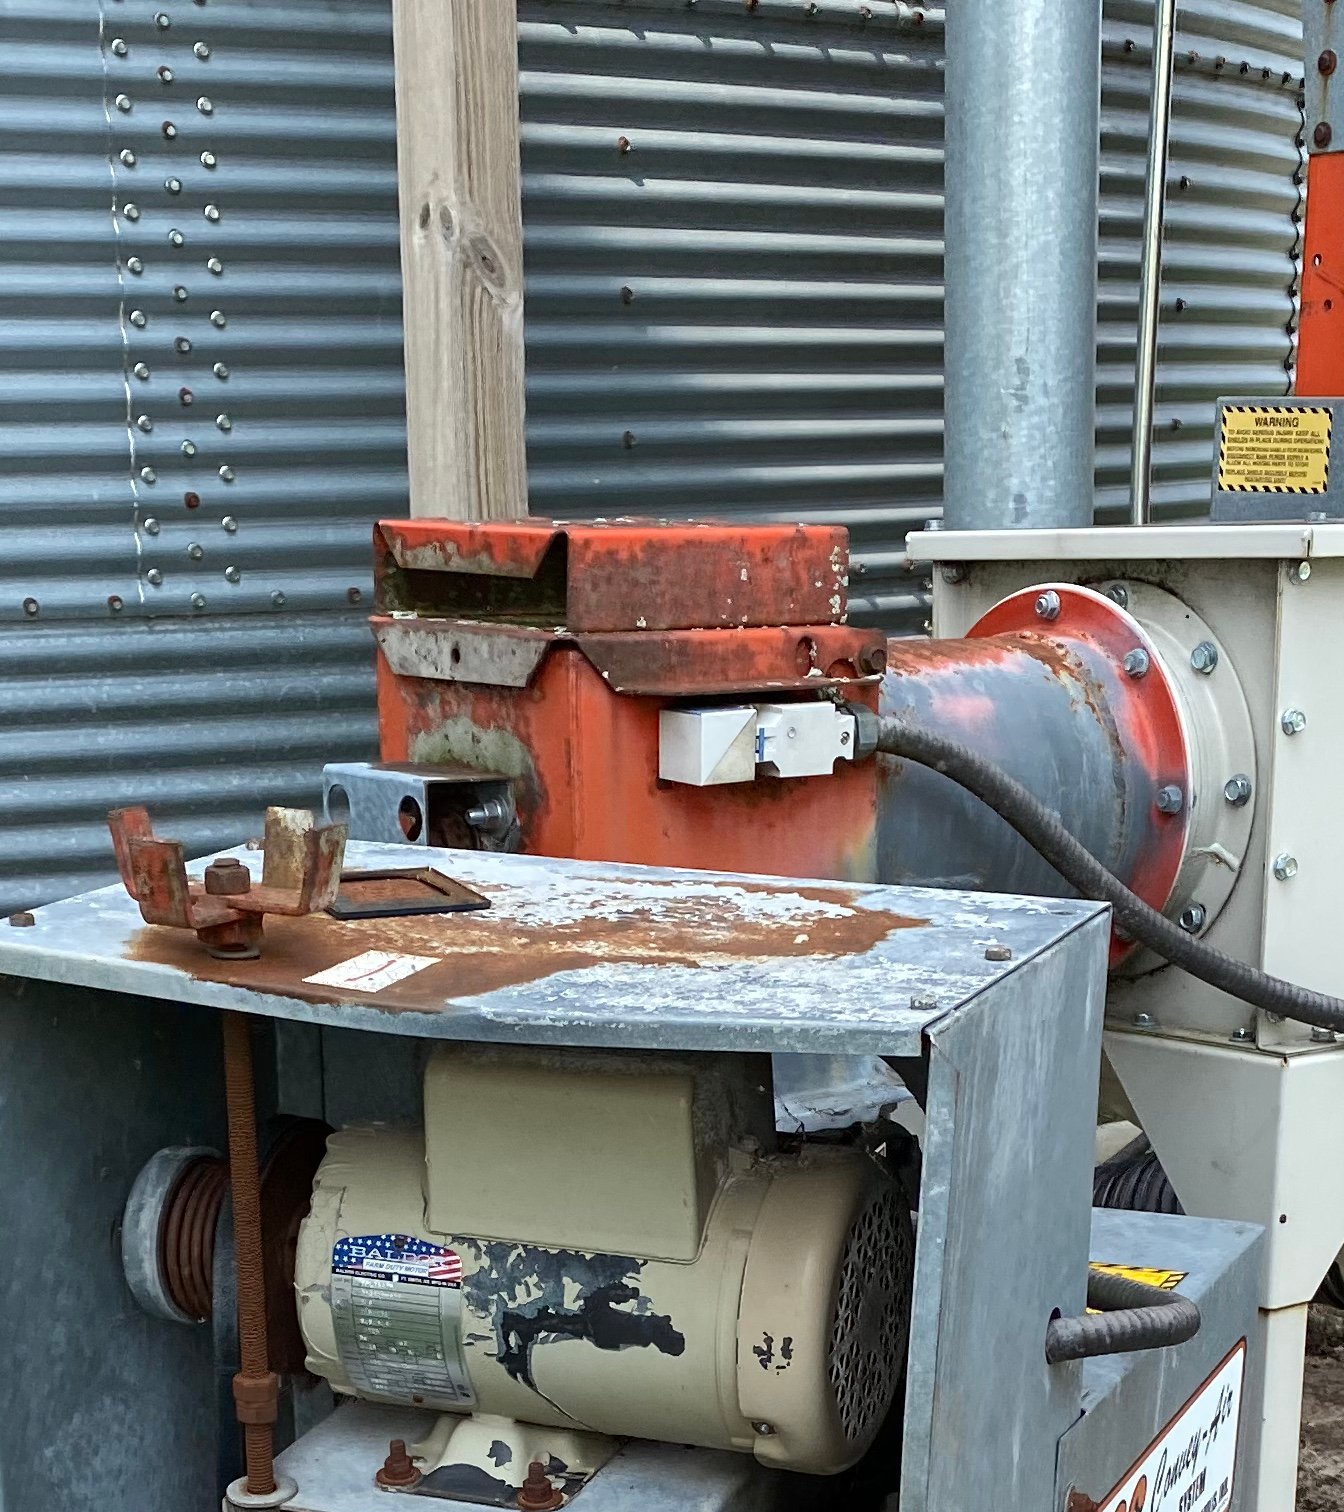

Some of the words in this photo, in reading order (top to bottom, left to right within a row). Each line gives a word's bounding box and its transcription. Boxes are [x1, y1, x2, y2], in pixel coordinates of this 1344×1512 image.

[1254, 417, 1299, 428] WARNING
[365, 1261, 385, 1269] FARM
[384, 1263, 404, 1272] DUTY
[404, 1266, 428, 1274] MOTOR
